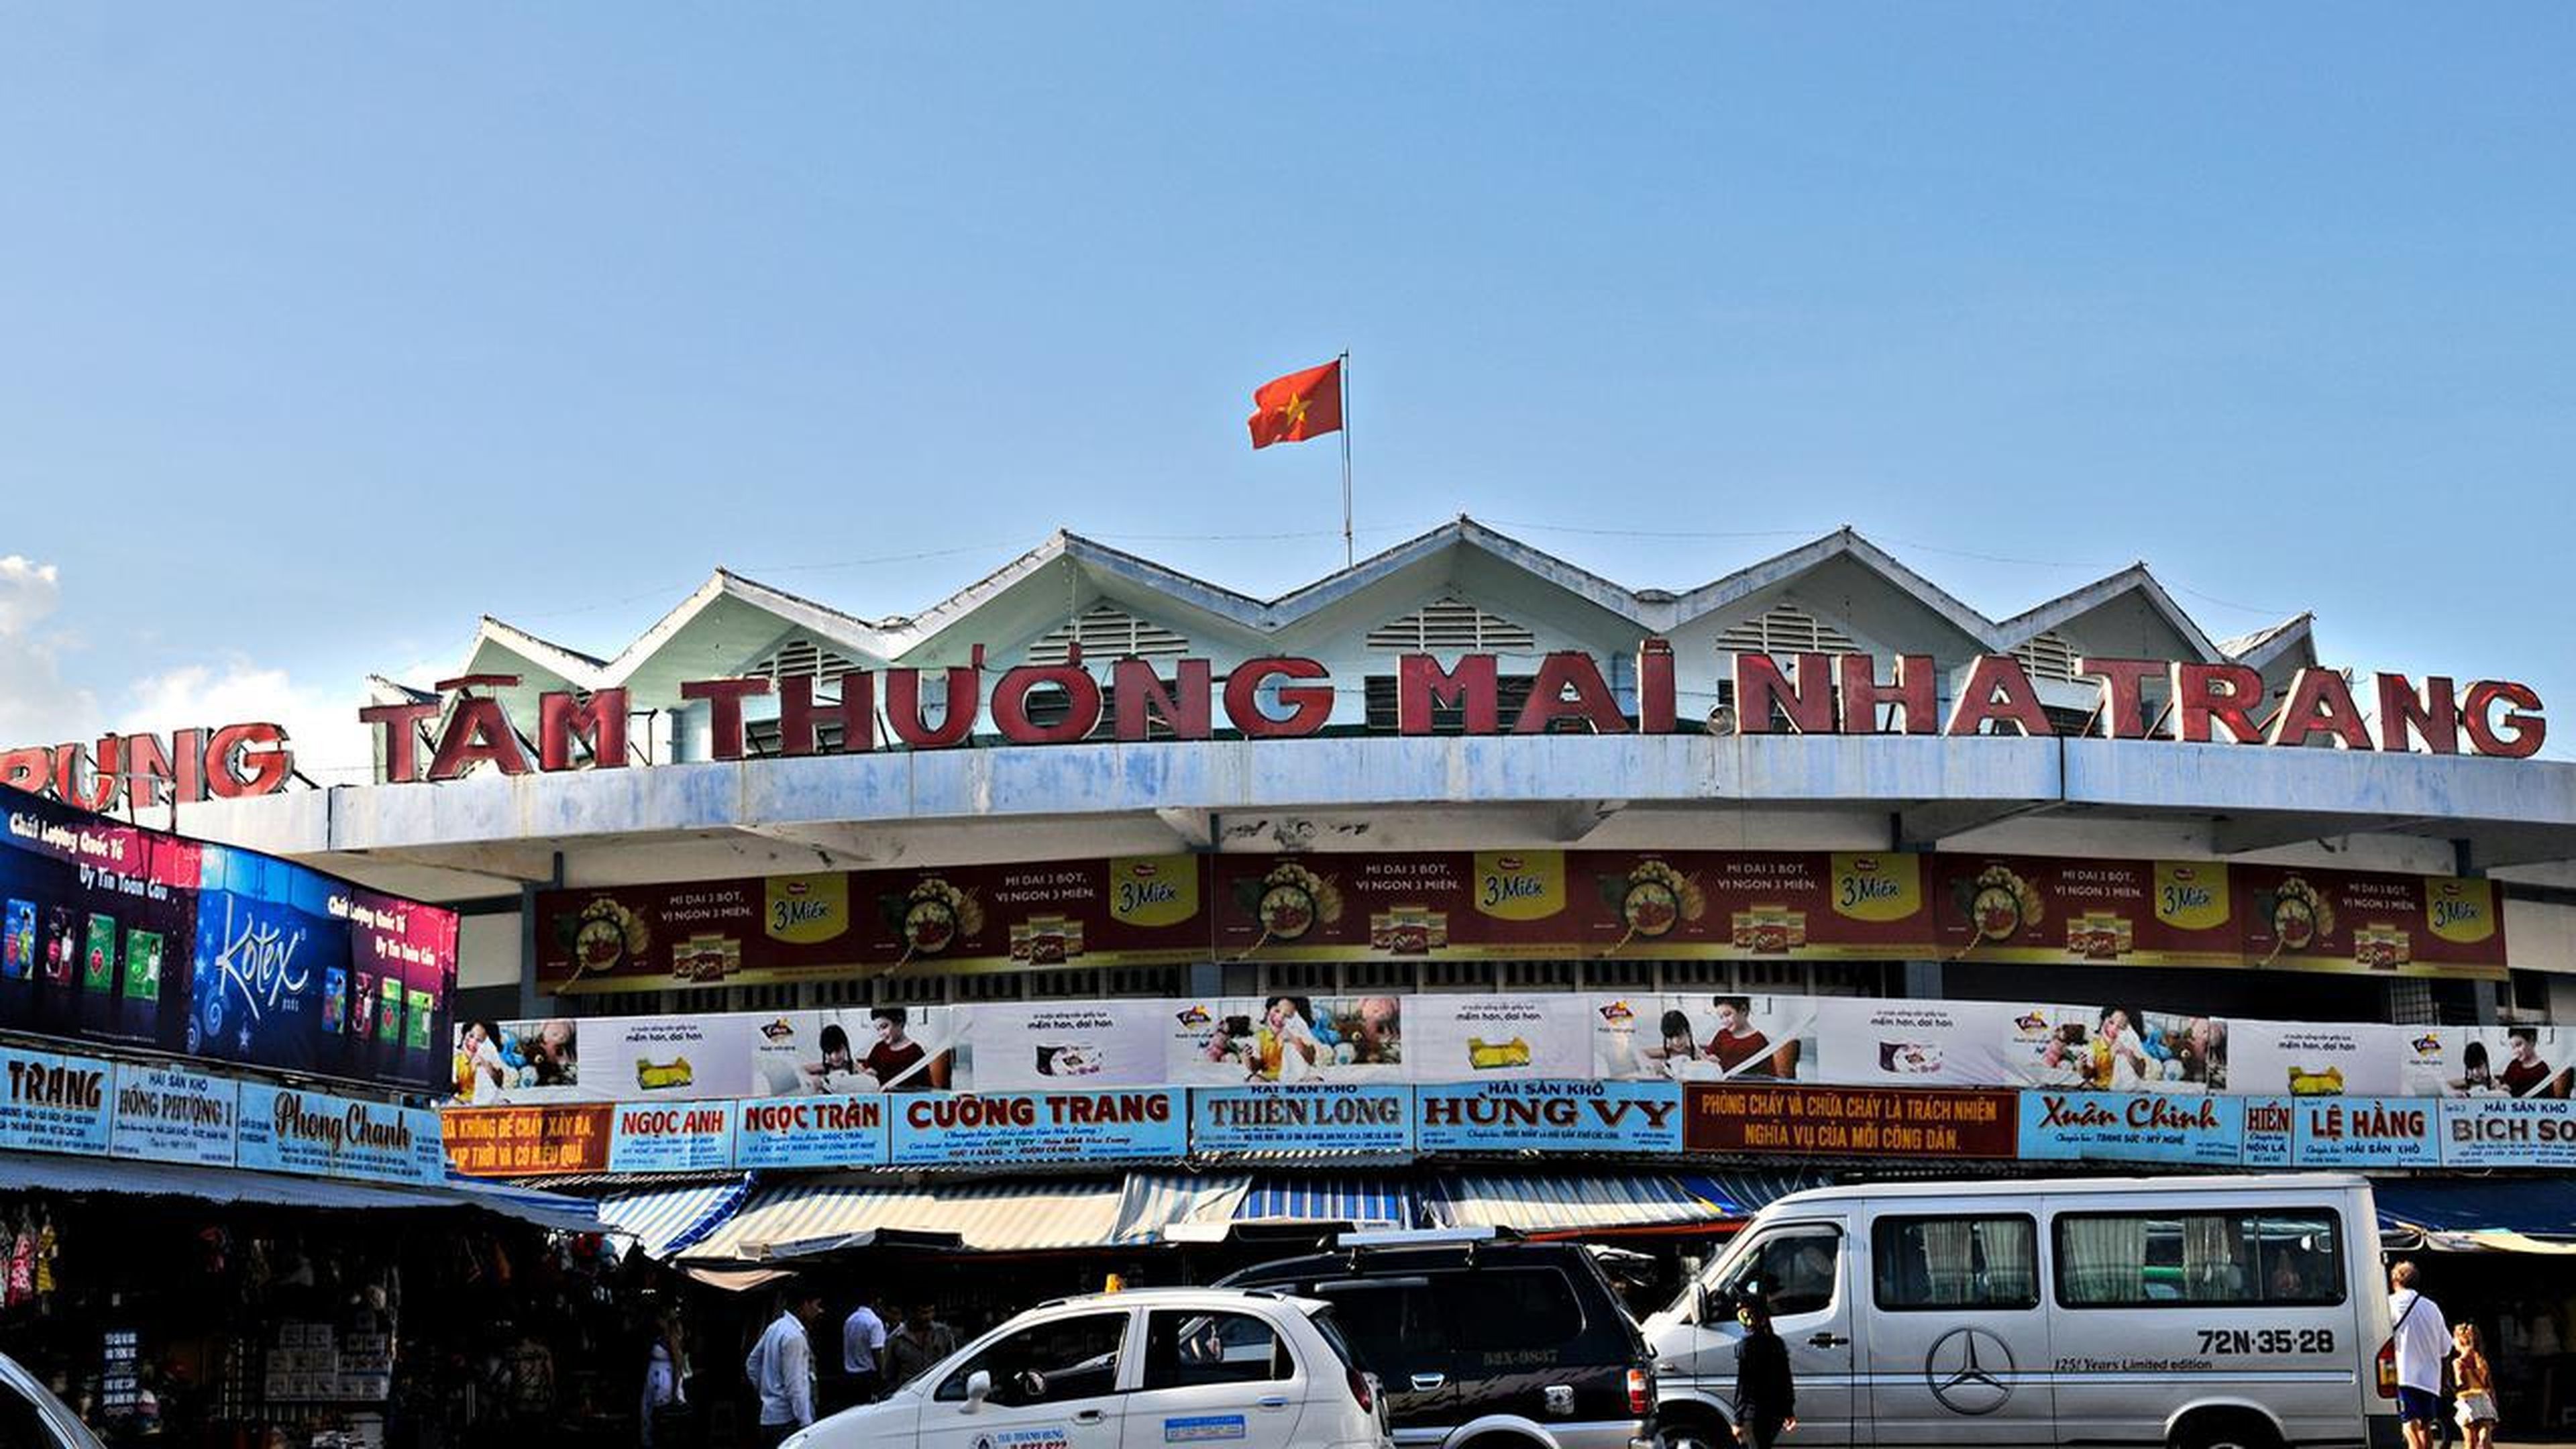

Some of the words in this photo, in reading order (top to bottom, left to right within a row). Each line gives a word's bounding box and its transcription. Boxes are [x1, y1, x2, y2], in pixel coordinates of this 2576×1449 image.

[680, 643, 1334, 760] THƯƠNG
[1733, 653, 2053, 736] NHA
[2074, 657, 2546, 757] TRANG
[1119, 883, 1133, 912] 3
[1372, 880, 1412, 891] NGON
[1484, 876, 1498, 906] 3
[1841, 877, 1856, 906] 3
[2163, 885, 2176, 914] 3
[674, 909, 710, 921] NGON
[774, 901, 788, 930] 3
[2434, 900, 2446, 928] 3
[215, 892, 309, 1020] Kotex
[8, 1061, 104, 1108] TRANG
[1044, 1093, 1170, 1125] TRANG
[1314, 1097, 1402, 1126] LONG
[1424, 1093, 1581, 1127] HÙNG
[1589, 1098, 1676, 1128] VY
[1701, 1089, 1746, 1115] PHÒNG
[1749, 1090, 1784, 1116] CHÁY
[1787, 1090, 1804, 1116] VÀ
[1846, 1093, 1881, 1118] CHÁY
[1885, 1094, 1902, 1119] LÀ
[1907, 1094, 1952, 1120] TRÁCH
[2039, 1095, 2119, 1128] Xuân
[274, 1091, 342, 1150] Phong
[621, 1110, 680, 1138] NGỌC
[682, 1110, 724, 1134] ANH
[745, 1105, 809, 1134] NGỌC
[1744, 1118, 1789, 1145] NGHĨA
[1818, 1120, 1847, 1147] CỦA
[2312, 1103, 2343, 1142] LỆ
[2451, 1114, 2529, 1141] BÍCH
